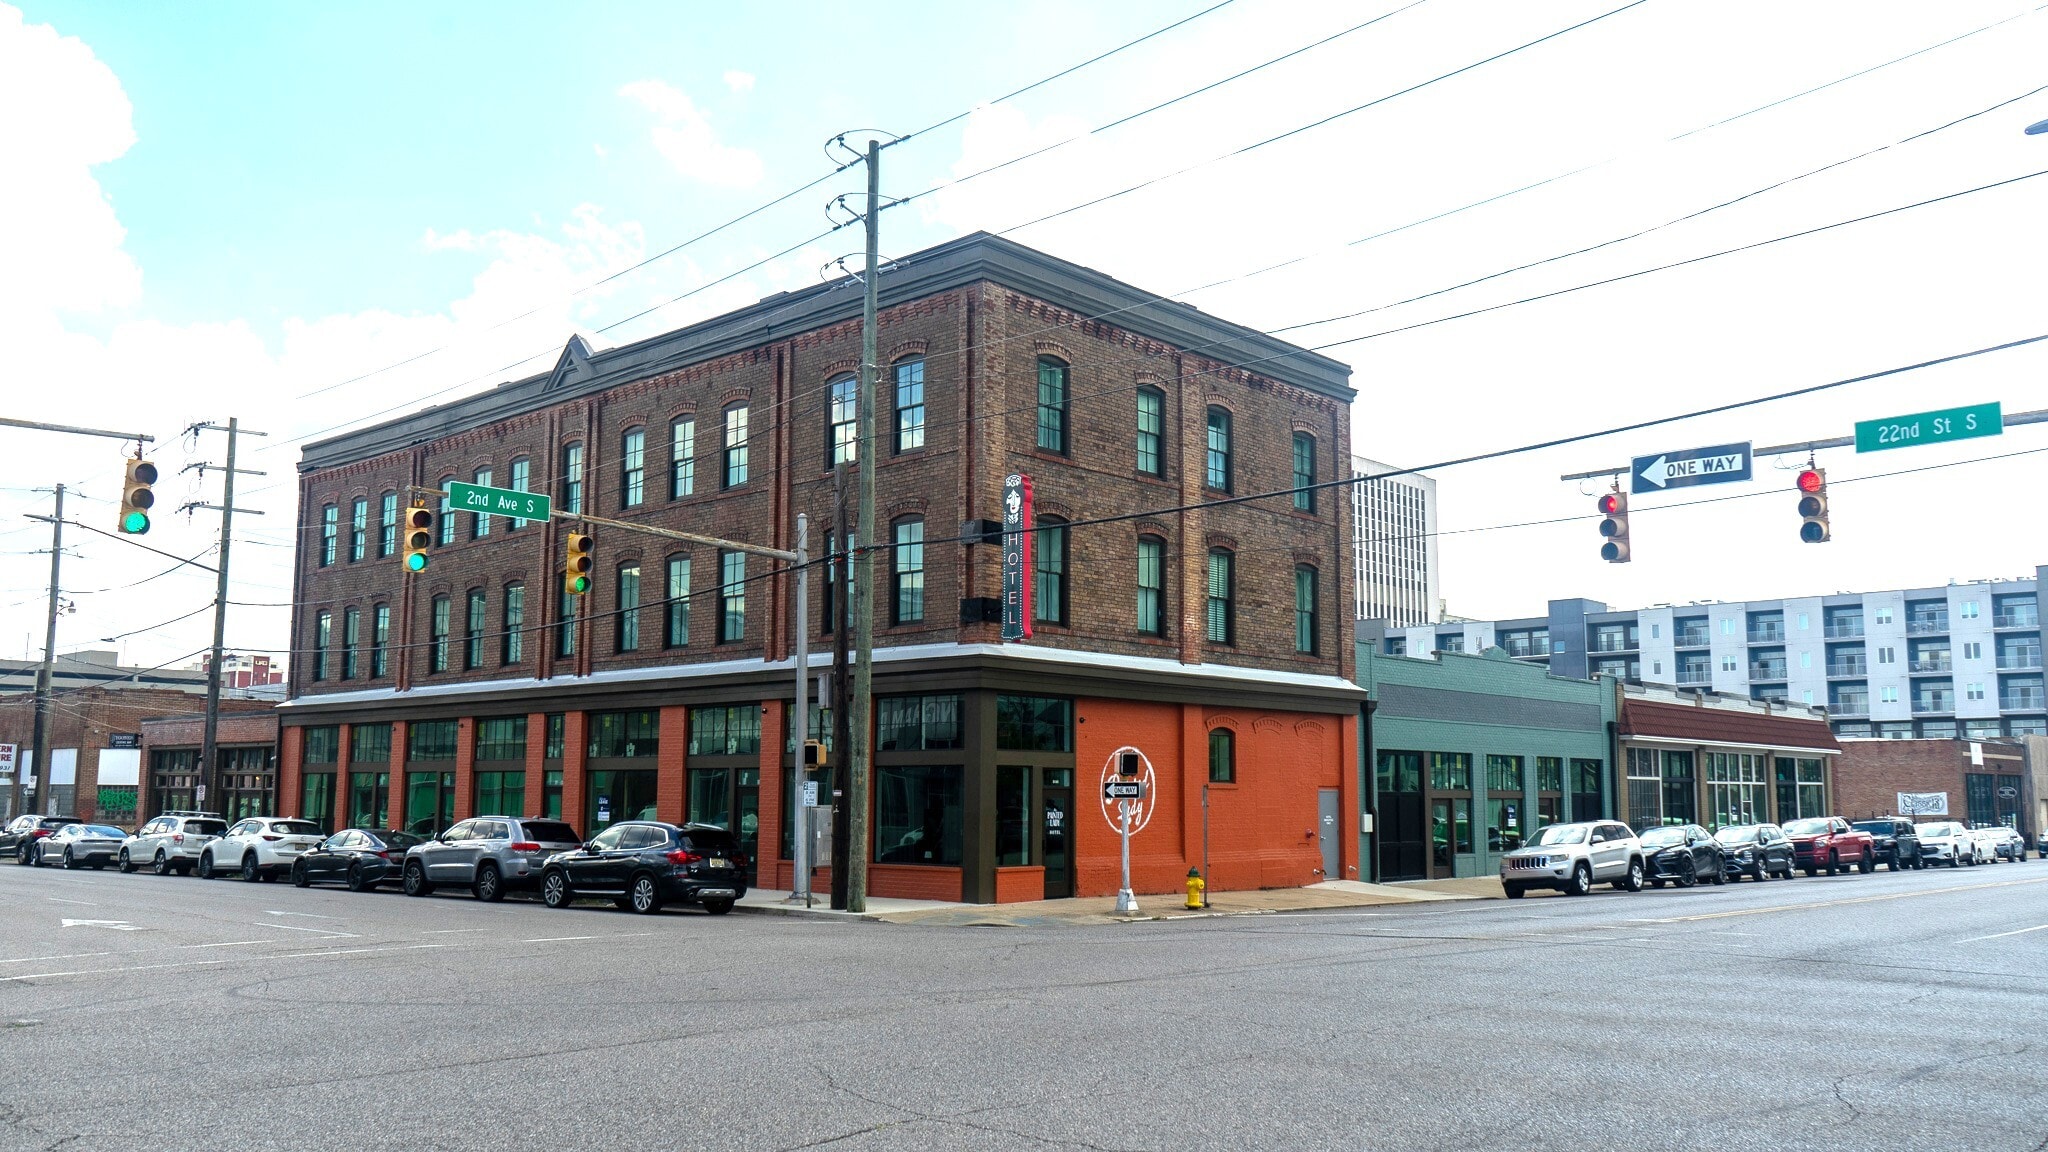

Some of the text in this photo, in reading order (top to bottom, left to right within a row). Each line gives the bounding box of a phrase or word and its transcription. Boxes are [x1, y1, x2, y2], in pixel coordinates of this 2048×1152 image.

[1878, 413, 1977, 443] 22nd St S
[1666, 455, 1737, 477] ONE WAY
[466, 490, 534, 513] 2nd Ave S
[1008, 532, 1019, 625] HOTEL
[1113, 786, 1137, 794] ONE WAY
